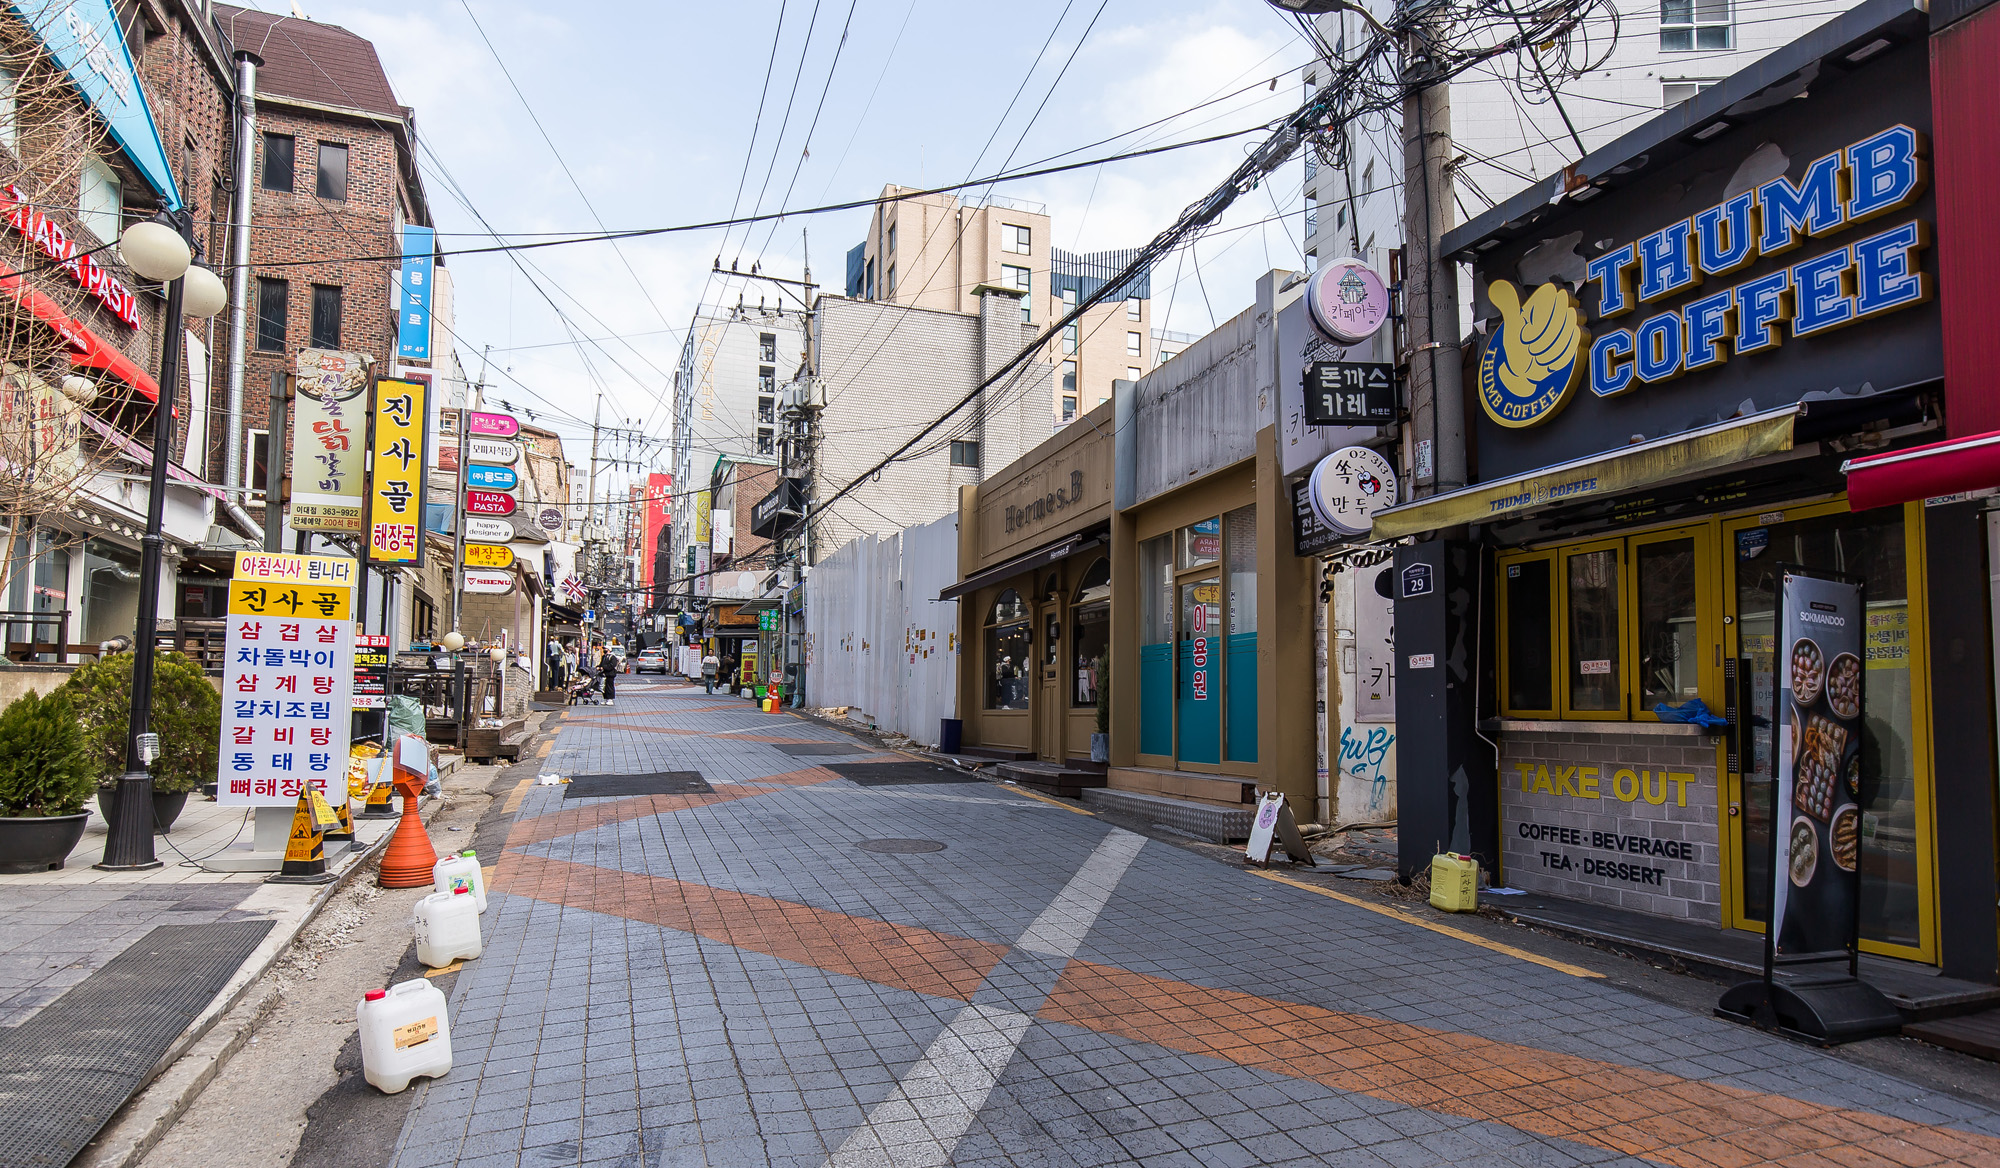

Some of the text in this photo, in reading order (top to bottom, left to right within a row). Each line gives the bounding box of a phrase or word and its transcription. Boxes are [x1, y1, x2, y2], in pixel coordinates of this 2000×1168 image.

[1586, 123, 1920, 319] THUMB
[12, 184, 142, 331] TIARA PASTA
[1331, 302, 1379, 323] 카페아늑
[1589, 218, 1926, 399] COFFEE
[1319, 365, 1390, 389] 돈까스
[1482, 346, 1560, 420] THUMB COFFEE
[1322, 392, 1367, 417] 카레
[380, 393, 418, 514] 진사골
[1349, 450, 1367, 460] 02
[1370, 455, 1389, 476] 313
[1335, 459, 1353, 485] 쏙
[474, 493, 506, 504] TIARA
[1004, 469, 1084, 535] Hermes.B
[1331, 495, 1369, 516] 만두
[1489, 477, 1598, 512] THUMB COFFEE
[1926, 494, 1957, 506] SECOM
[296, 505, 359, 517] 이대점 363-9922
[474, 502, 506, 512] PASTA
[293, 515, 322, 527] 단체예약
[323, 517, 344, 528] 200석
[476, 521, 500, 530] happy
[373, 523, 417, 553] 해장국
[468, 546, 509, 561] 해장국
[241, 555, 350, 582] 아침식사 됩니다
[476, 578, 512, 586] SBENU
[1410, 578, 1424, 592] 29
[239, 586, 342, 617] 진사골
[1799, 611, 1846, 627] SOKMANDOO
[238, 621, 340, 644] 삼겹살
[370, 636, 387, 646] 금지
[236, 646, 335, 669] 차돌박이
[1192, 603, 1208, 701] 이용원
[234, 672, 336, 695] 삼계탕
[233, 699, 331, 721] 갈치조림
[231, 725, 333, 746] 갈비탕
[230, 751, 331, 772] 동태탕
[229, 777, 329, 798] 뼈해장국
[1514, 762, 1696, 808] TAKE OUT
[1518, 821, 1693, 861] COFFEE BEVERAGE
[1540, 851, 1665, 886] TEA DESSERT
